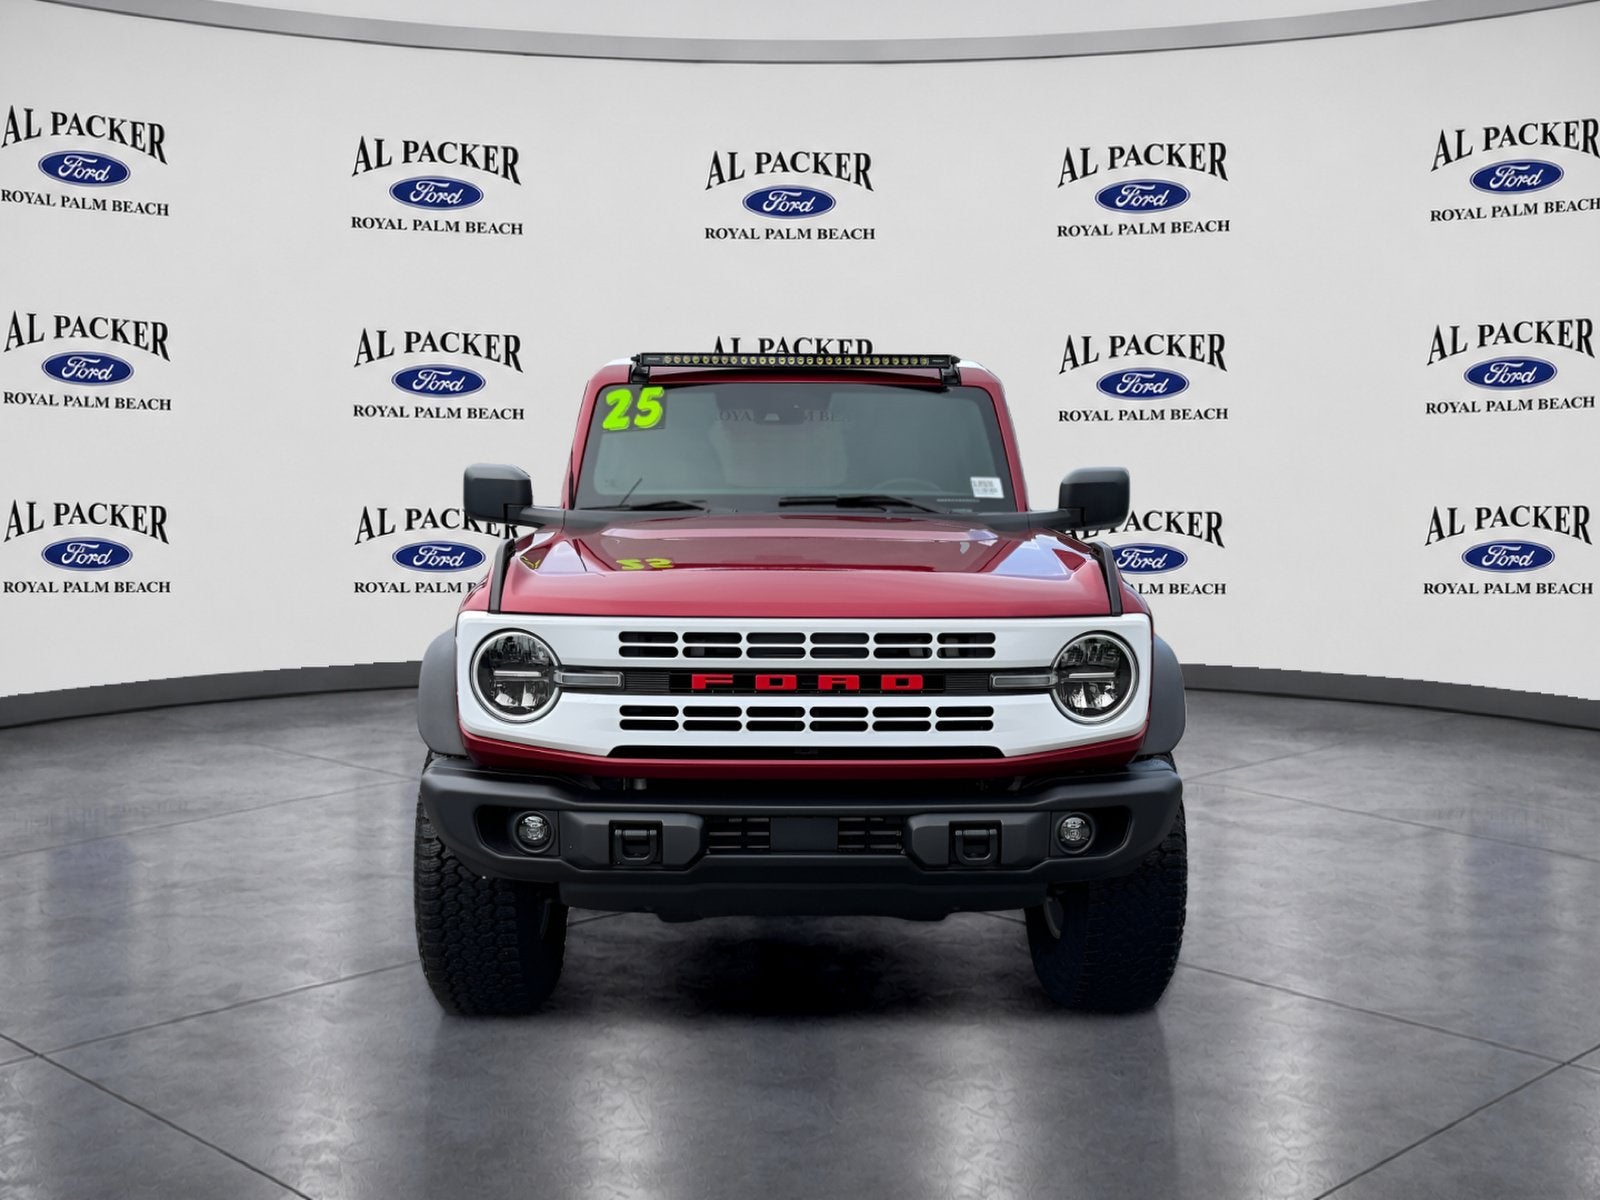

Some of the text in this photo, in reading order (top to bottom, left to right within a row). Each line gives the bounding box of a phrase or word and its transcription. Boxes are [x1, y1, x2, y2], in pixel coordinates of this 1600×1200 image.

[1, 105, 167, 165] AL PACKER
[1431, 119, 1600, 172] AL PACKER
[58, 156, 110, 181] Ford
[352, 136, 521, 185] AL PACKER
[706, 151, 873, 191] AL PACKER
[1058, 143, 1228, 188] AL PACKER
[1490, 165, 1543, 188] Ford
[1, 189, 168, 216] ROYAL PALM BEACH
[410, 181, 463, 204] Ford
[763, 191, 815, 212] Ford
[1116, 185, 1169, 206] Ford
[1431, 198, 1600, 221] ROYAL PALM BEACH
[352, 217, 522, 235] ROYAL PALM BEACH
[705, 228, 875, 239] ROYAL PALM BEACH
[1058, 220, 1230, 237] ROYAL PALM BEACH
[4, 311, 170, 361] AL PACKER
[1427, 319, 1595, 365] AL PACKER
[354, 328, 523, 373] AL PACKER
[1059, 334, 1227, 374] AL PACKER
[62, 357, 113, 380] Ford
[1484, 363, 1537, 383] Ford
[413, 370, 465, 391] Ford
[1117, 373, 1169, 393] Ford
[4, 392, 171, 410] ROYAL PALM BEACH
[603, 387, 664, 430] 25
[1426, 396, 1594, 414] ROYAL PALM BEACH
[354, 405, 524, 419] ROYAL PALM BEACH
[1059, 408, 1228, 421] ROYAL PALM BEACH
[4, 500, 169, 544] AL PACKER
[355, 506, 395, 545] AL
[1109, 511, 1224, 548] ACKER
[1425, 505, 1592, 546] AL PACKER
[62, 543, 112, 564] Ford
[413, 546, 465, 567] Ford
[1117, 548, 1168, 569] Ford
[1482, 545, 1534, 566] Ford
[4, 581, 170, 593] ROYAL PALM BEACH
[355, 582, 410, 593] ROYAL
[415, 582, 461, 593] PALM
[1169, 583, 1226, 594] BEACH
[1424, 583, 1593, 594] ROYAL PALM BEACH
[692, 674, 923, 690] FORD
